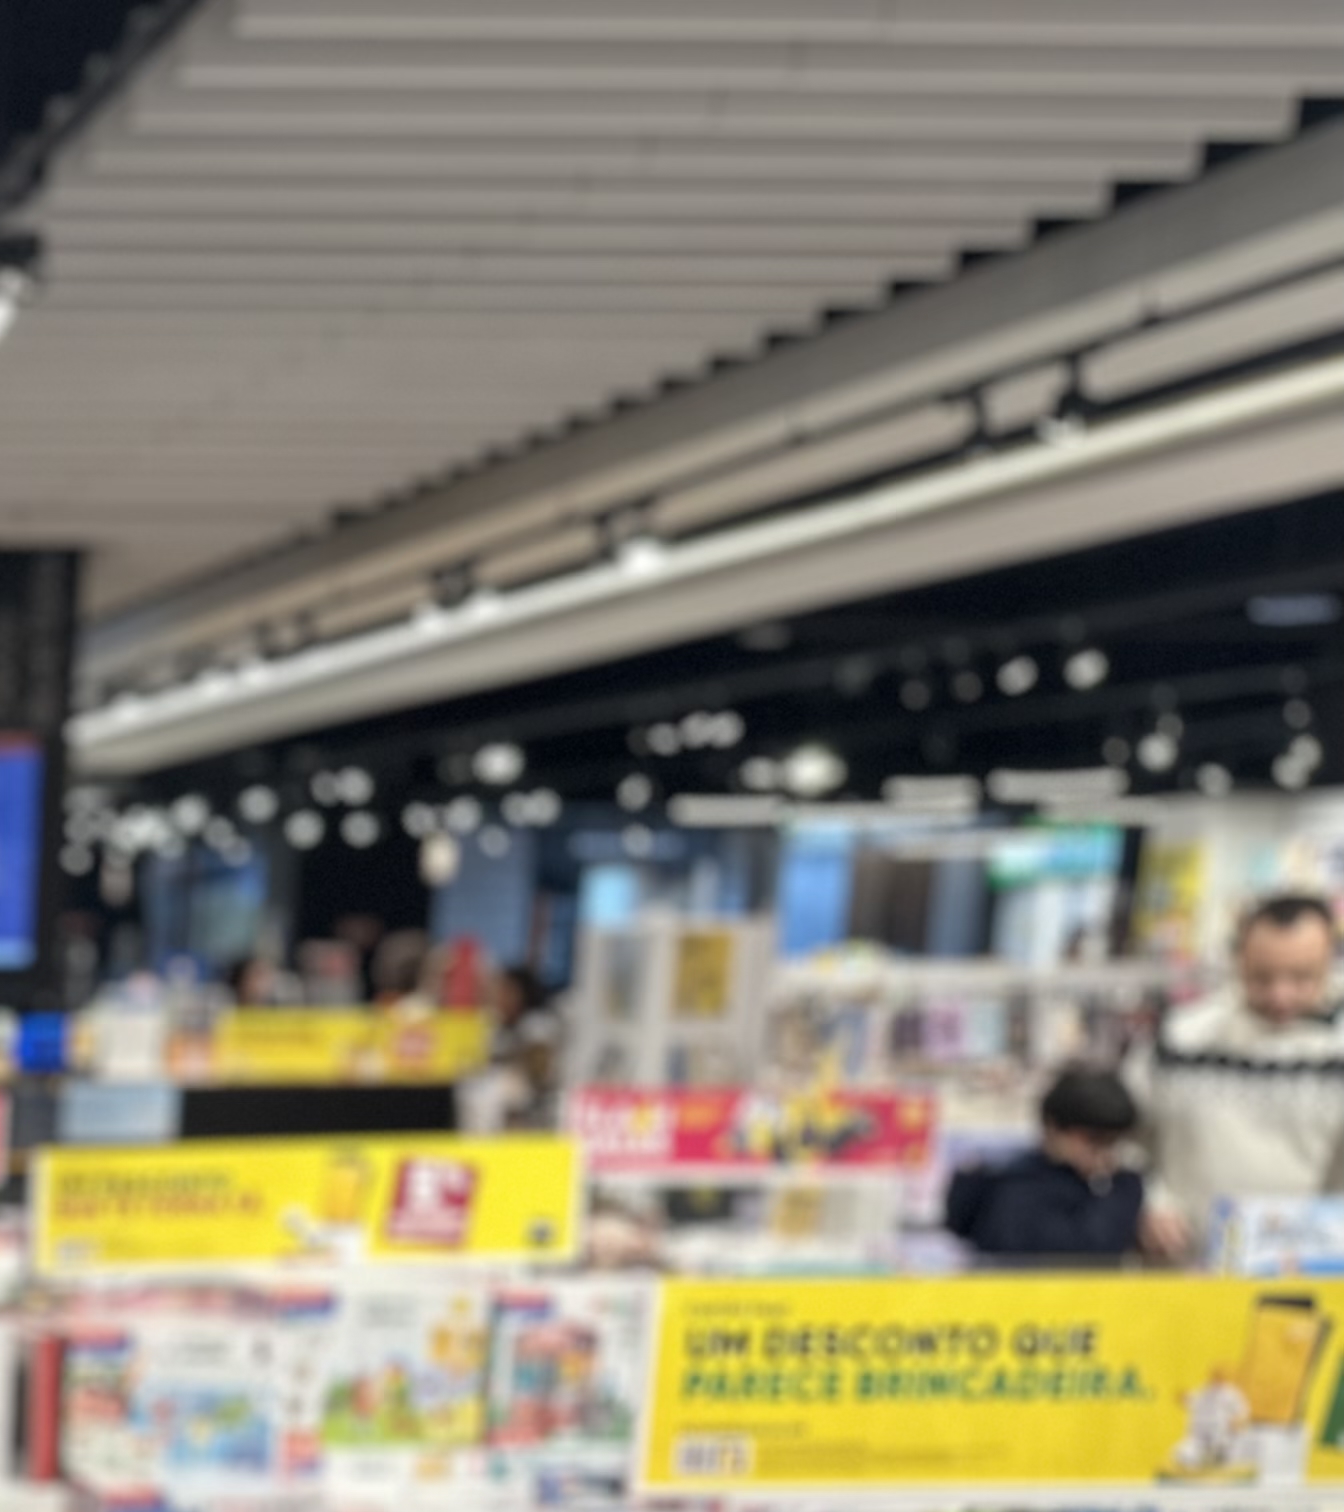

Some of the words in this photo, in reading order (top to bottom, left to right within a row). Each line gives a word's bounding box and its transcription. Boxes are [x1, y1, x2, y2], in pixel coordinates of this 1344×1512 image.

[684, 1320, 750, 1359] UM
[763, 1319, 1000, 1360] DESCONTO
[1014, 1319, 1099, 1358] QUE
[682, 1366, 841, 1400] PARECE
